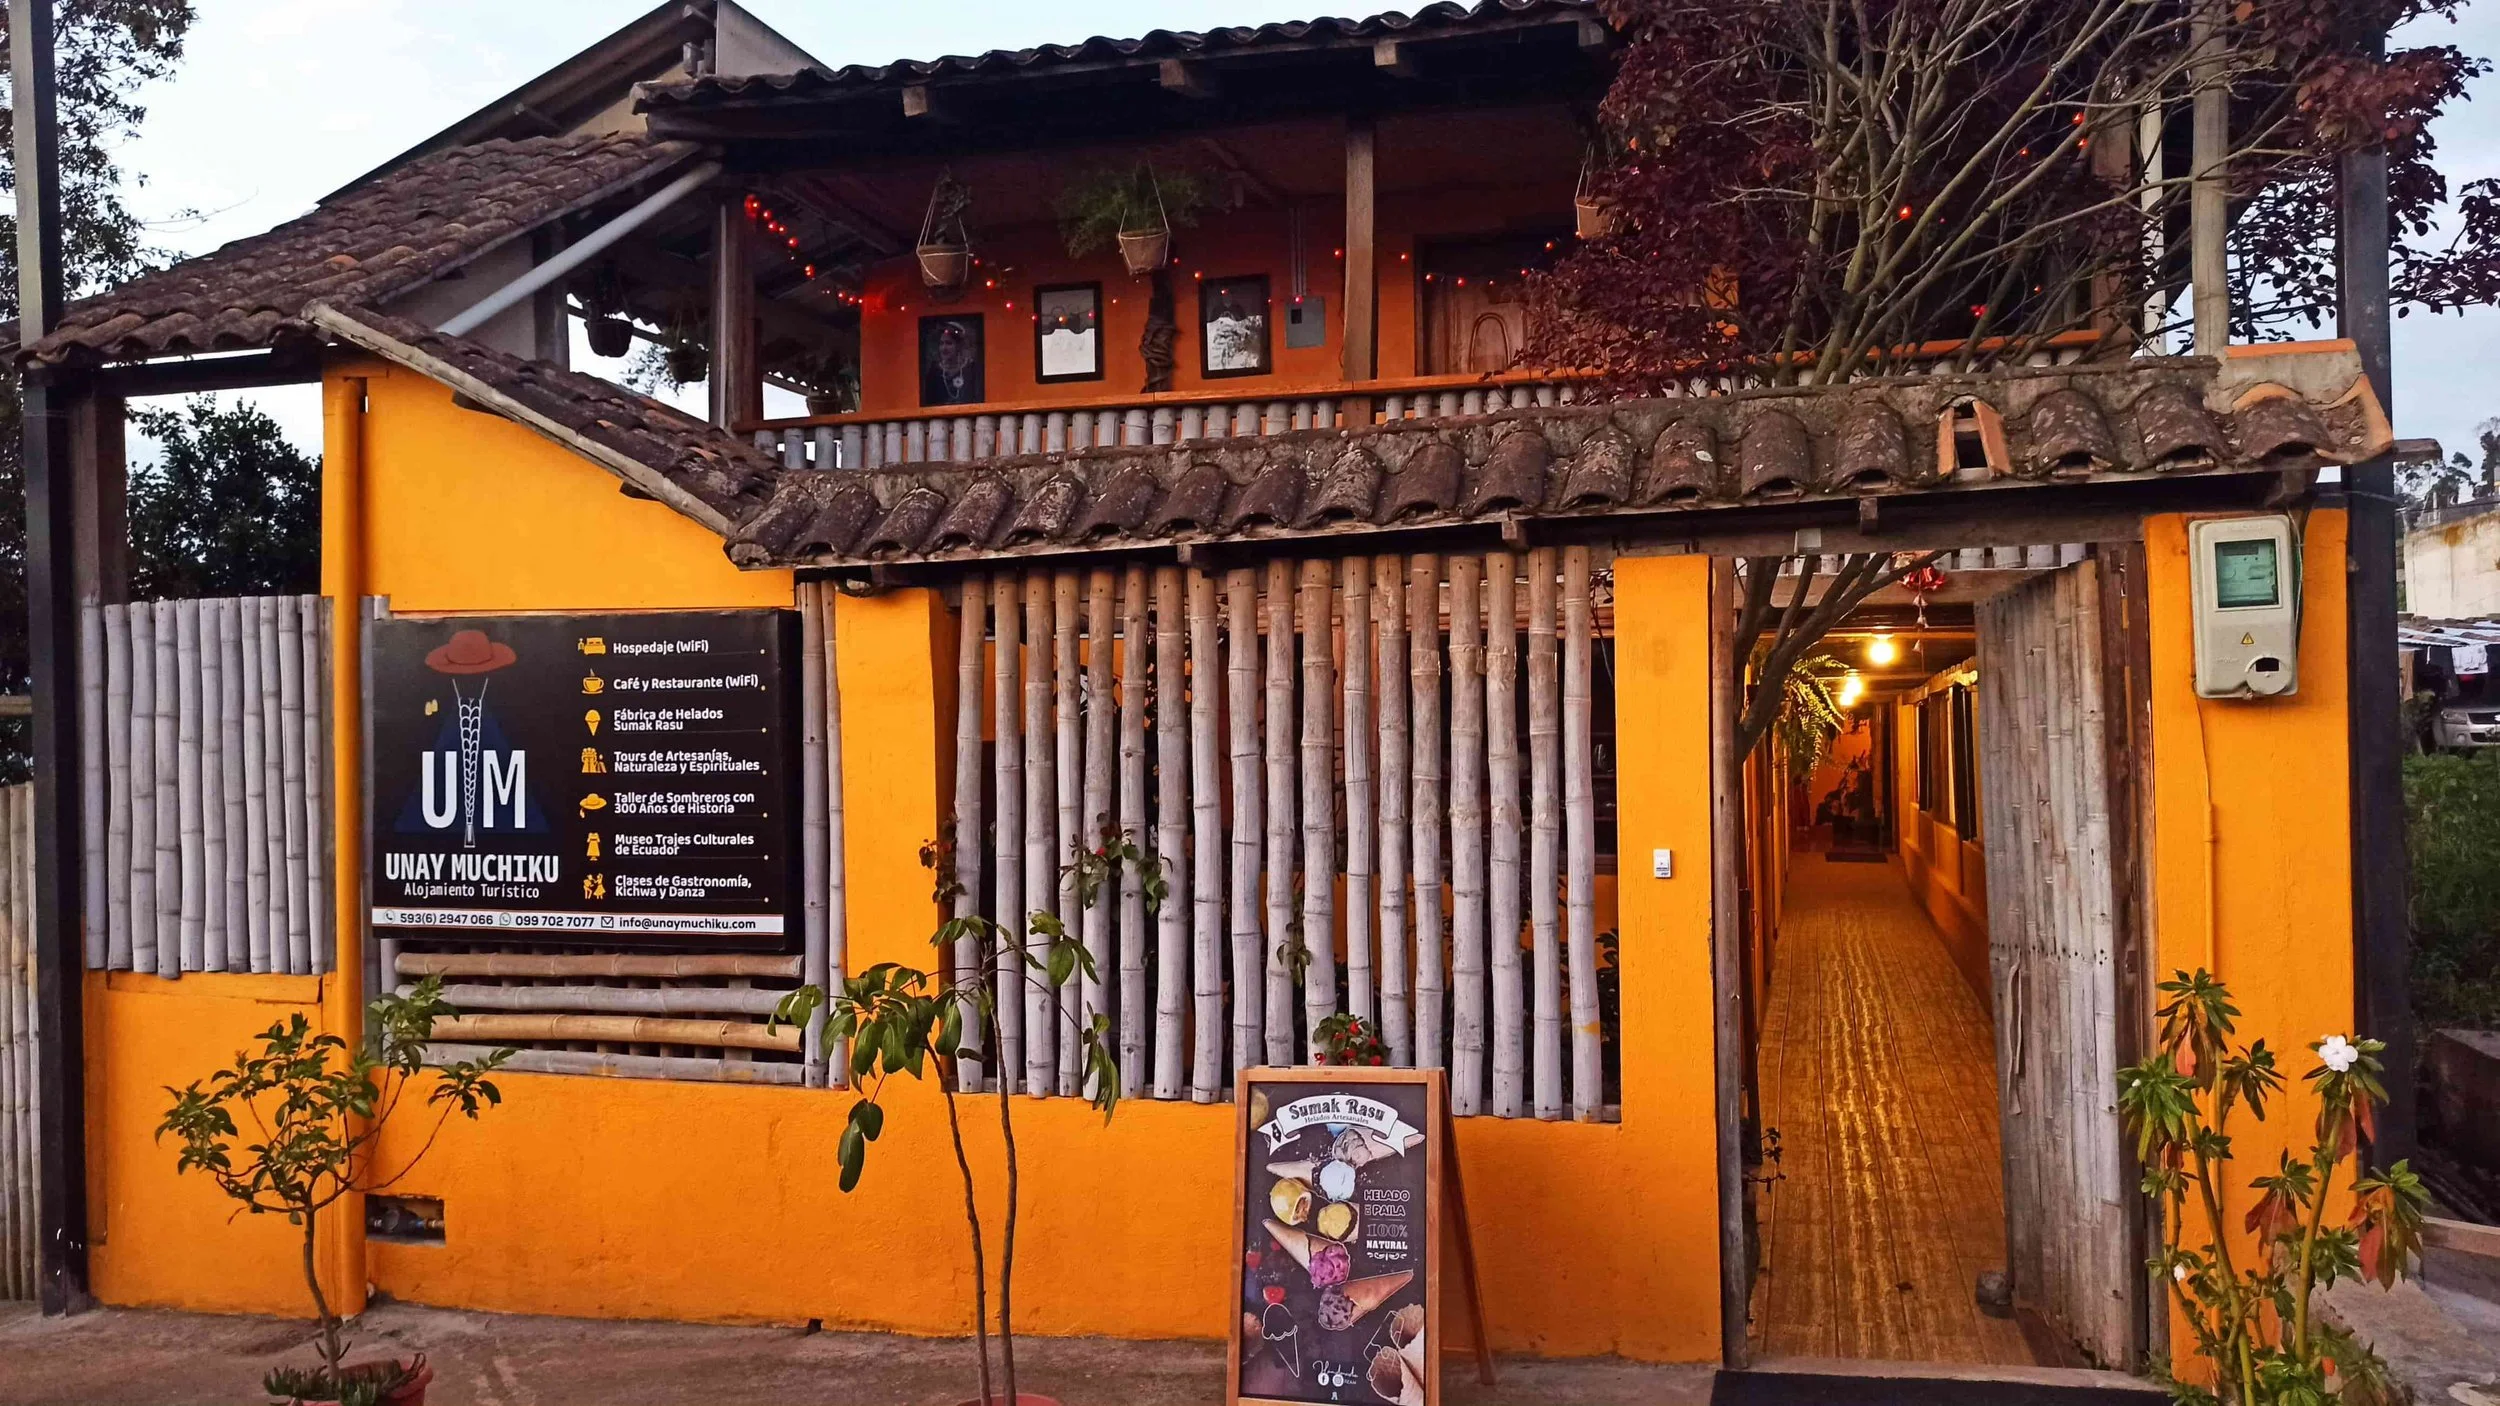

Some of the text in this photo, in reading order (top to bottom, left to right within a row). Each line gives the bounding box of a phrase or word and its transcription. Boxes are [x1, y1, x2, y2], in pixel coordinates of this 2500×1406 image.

[613, 639, 709, 656] Hospedaje (WiFi)
[613, 674, 759, 692] Café y Restaurante (WiFi)
[613, 708, 723, 721] Fábrica de Helados
[613, 720, 684, 731] Sumak Rasu
[614, 749, 732, 763] Tours de Artesanías,
[614, 760, 760, 774] Naturaleza y Espirituales
[614, 792, 754, 804] Taller de Sombreros con
[614, 803, 637, 814] 300
[639, 802, 668, 814] Años
[670, 803, 685, 814] de
[615, 834, 754, 846] Museo Trajes Culturales
[615, 845, 680, 855] de Ecuador
[385, 853, 559, 883] UNAY MUCHIKU
[615, 874, 752, 888] Clases de Gastronomía,
[404, 882, 540, 899] Alojamiento Turístico
[615, 886, 706, 899] Kichwa y Danza
[400, 913, 494, 925] 593(6) 2947 066
[515, 915, 595, 927] 099 702 7077
[619, 917, 756, 931] info@unaymuchiku.com
[1288, 1098, 1386, 1122] Sumak Rasu
[1364, 1189, 1410, 1202] HELADO
[1372, 1204, 1406, 1217] PAILA
[1366, 1224, 1408, 1238] 100%
[1366, 1240, 1408, 1250] NATURAL
